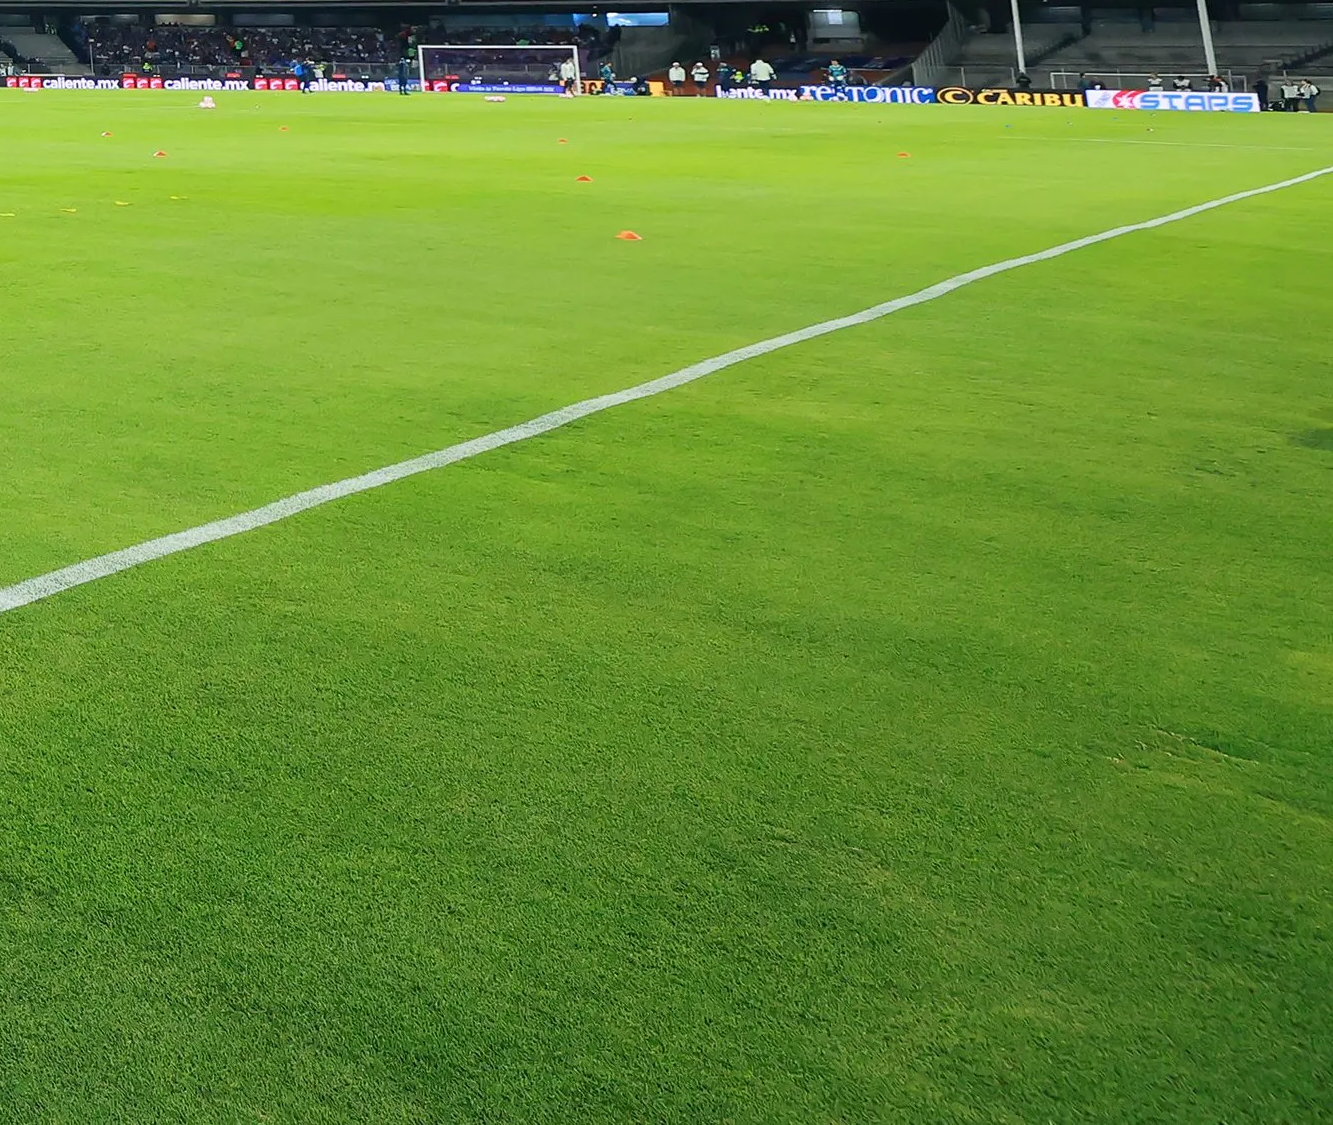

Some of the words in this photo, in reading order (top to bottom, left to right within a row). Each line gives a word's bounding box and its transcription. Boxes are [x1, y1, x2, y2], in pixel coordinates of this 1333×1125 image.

[43, 77, 120, 89] caliente.mx
[164, 77, 250, 90] caliente.mx
[977, 92, 1084, 107] CARIBU
